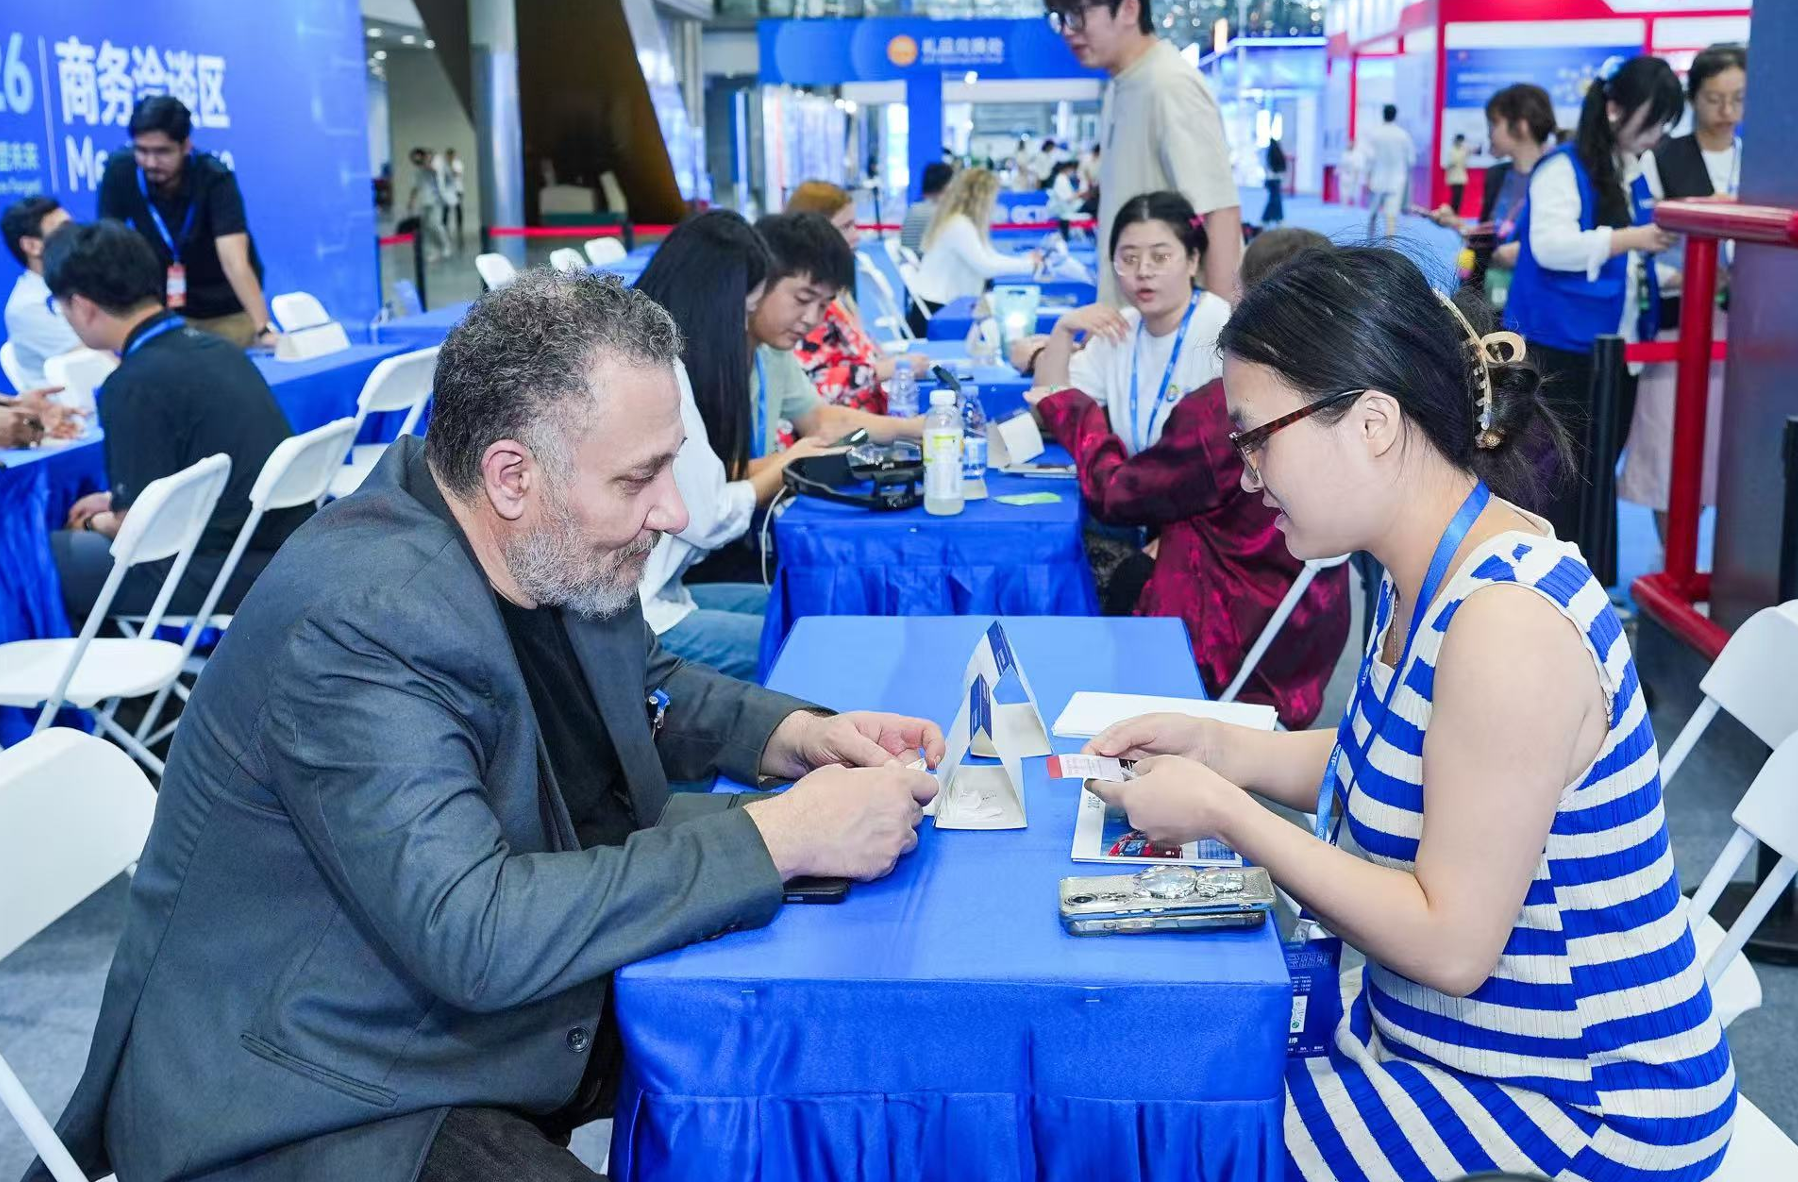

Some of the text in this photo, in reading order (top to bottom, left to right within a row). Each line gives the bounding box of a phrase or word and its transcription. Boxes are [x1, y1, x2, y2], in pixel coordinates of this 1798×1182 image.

[54, 35, 231, 129] 商务洽谈区
